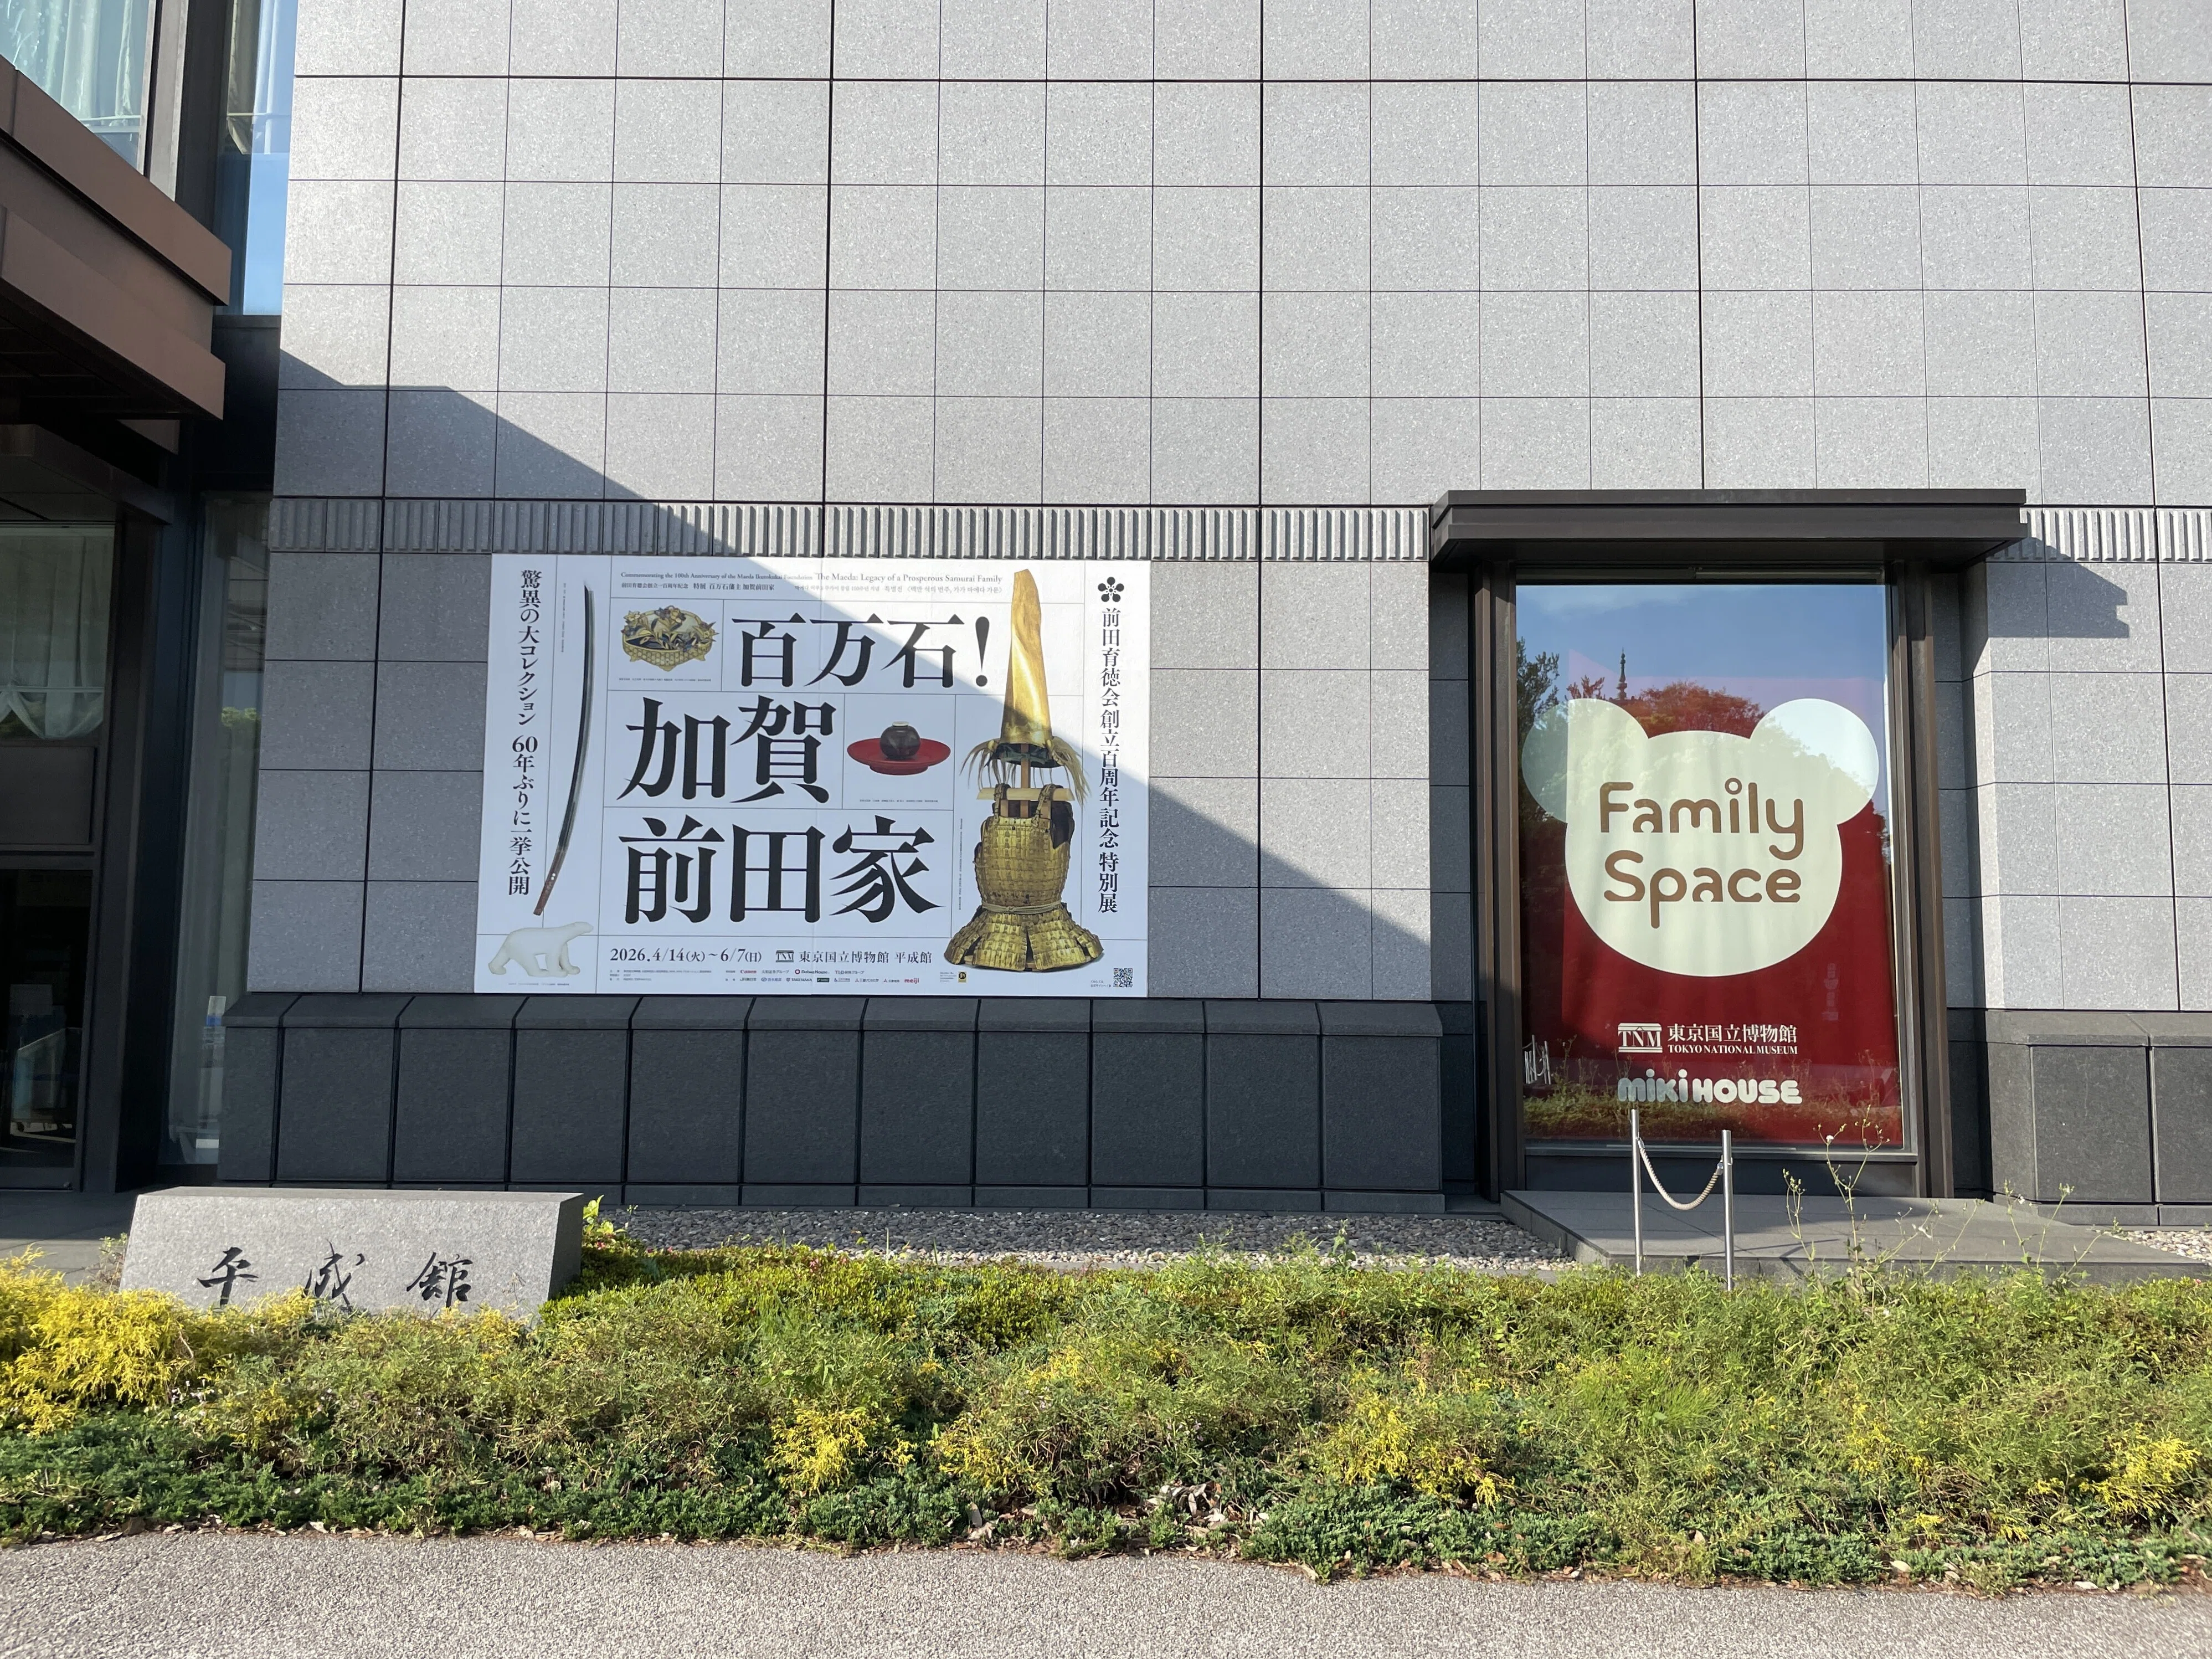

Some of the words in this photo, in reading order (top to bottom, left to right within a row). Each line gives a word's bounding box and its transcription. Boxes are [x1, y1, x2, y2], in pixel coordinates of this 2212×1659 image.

[861, 574, 886, 583] Legacy
[903, 574, 943, 583] Prosperous
[978, 575, 1003, 584] Family
[517, 570, 542, 725] 驚異の大コレクション
[616, 695, 836, 803] 加賀
[508, 735, 538, 895] 60年ぶりに一挙公開
[1599, 778, 1804, 860] Family
[618, 814, 945, 925] 前田家
[1604, 850, 1802, 929] Space
[799, 951, 889, 963] 東京国立博物館
[894, 952, 932, 963] 平成館
[1667, 1023, 1797, 1043] 東京国立博物館
[1668, 1045, 1702, 1053] TOKYO
[1704, 1045, 1755, 1054] NATIONAL
[1757, 1046, 1798, 1055] MUSEUM
[1618, 1069, 1688, 1102] miki
[1693, 1078, 1803, 1104] HOUSE
